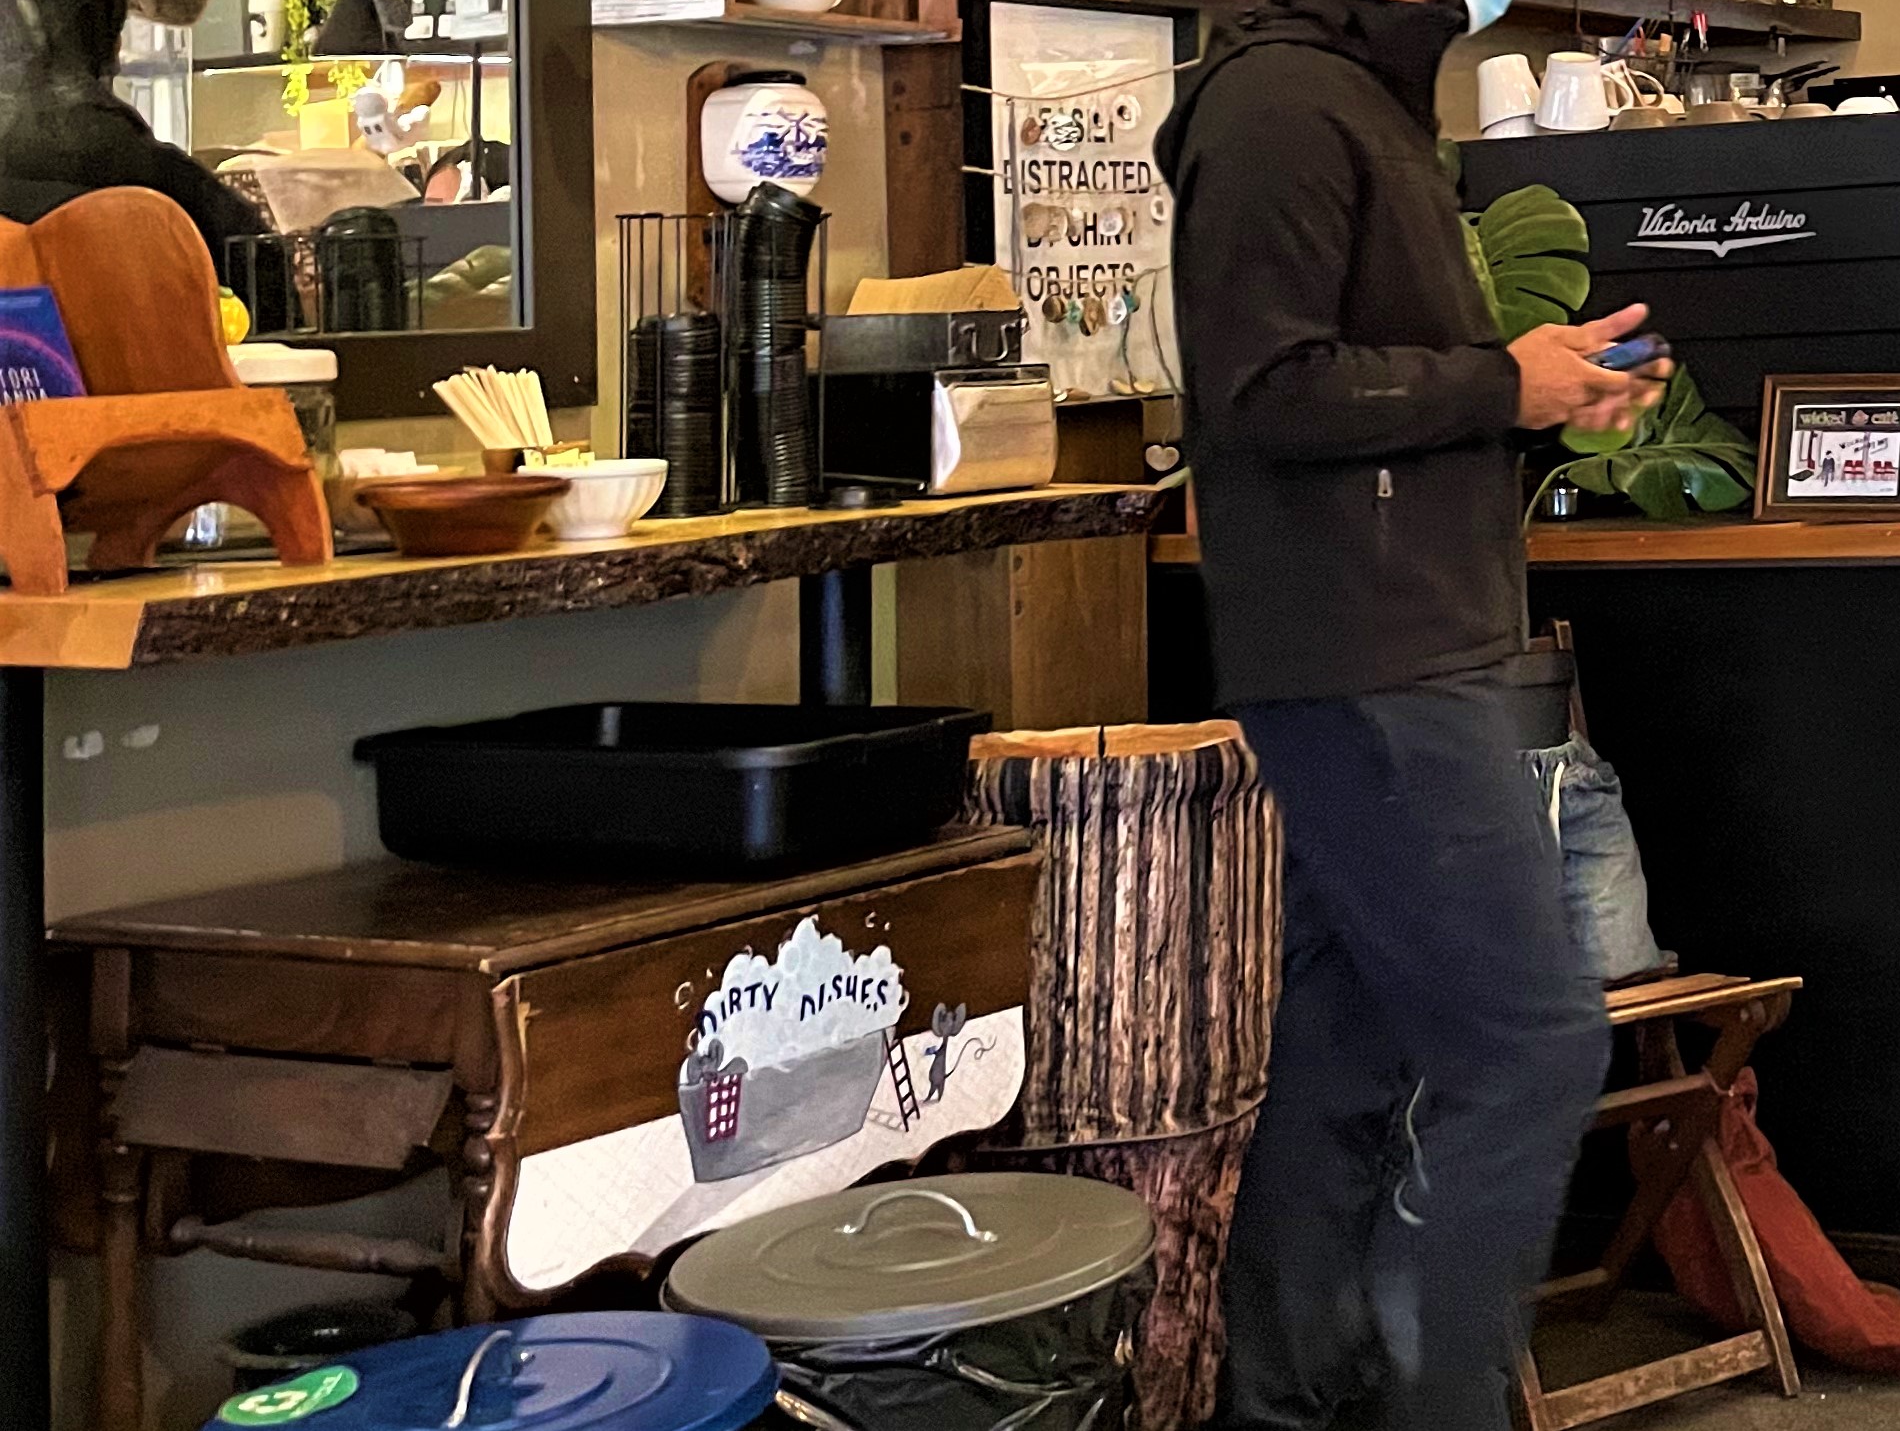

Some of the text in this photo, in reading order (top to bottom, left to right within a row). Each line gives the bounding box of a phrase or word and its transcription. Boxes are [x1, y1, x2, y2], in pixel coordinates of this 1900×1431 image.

[1637, 200, 1806, 237] Victoria Arduino
[695, 981, 780, 1038] DIRTY
